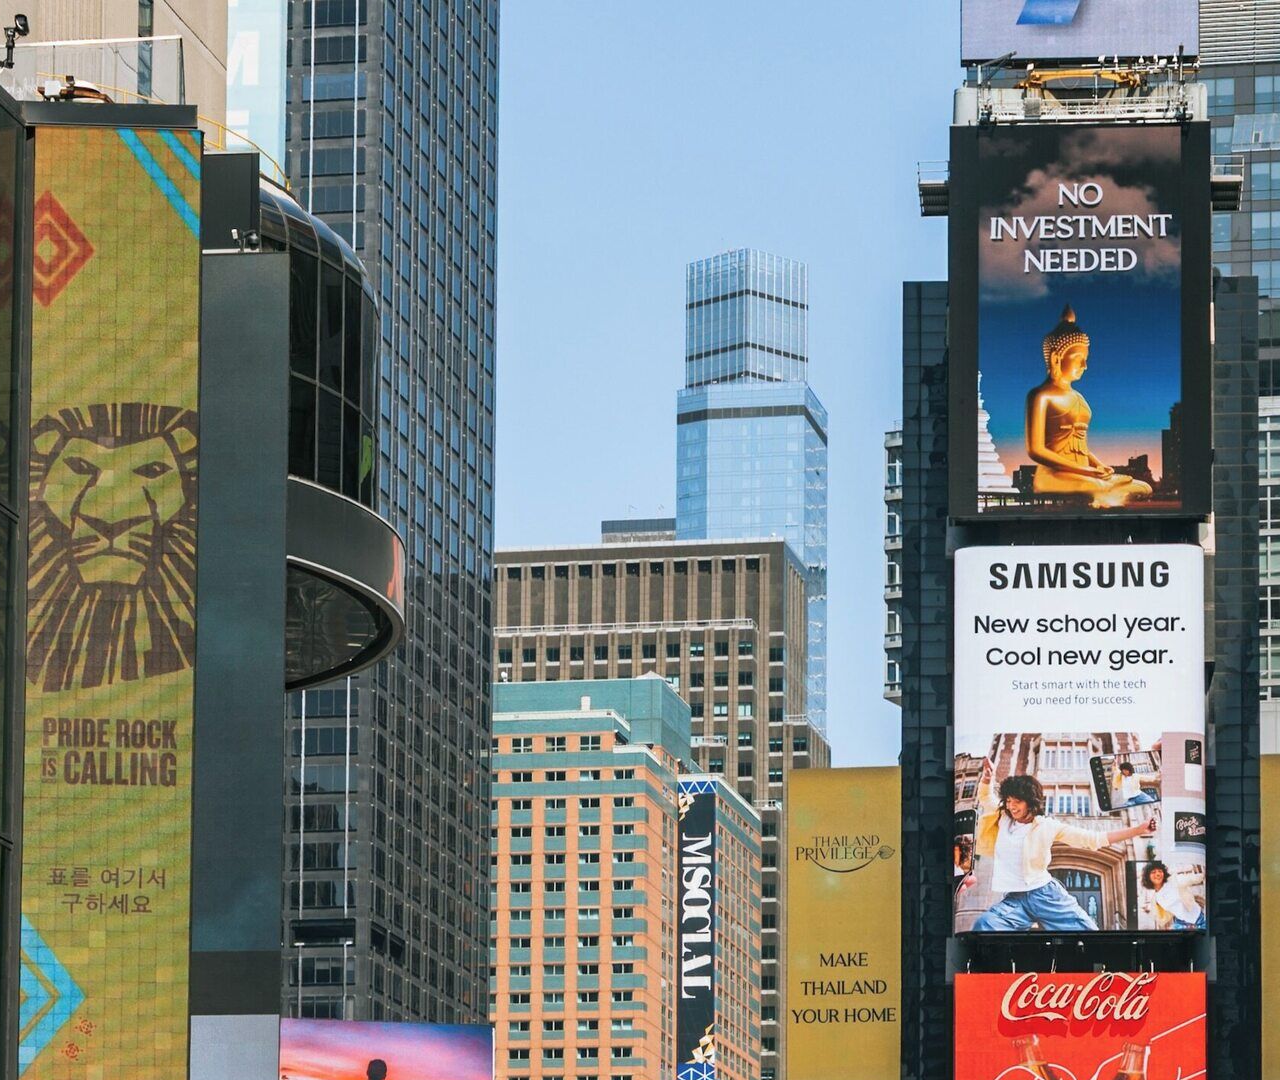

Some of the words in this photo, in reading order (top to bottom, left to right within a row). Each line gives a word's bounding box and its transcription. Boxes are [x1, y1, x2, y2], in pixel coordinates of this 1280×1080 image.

[1057, 182, 1103, 207] NO
[990, 213, 1172, 241] INVESTMENT
[1023, 247, 1138, 275] NEEDED
[989, 560, 1170, 590] SAMSUNG
[973, 614, 1030, 634] New
[1036, 613, 1117, 633] school
[1123, 615, 1186, 638] year.
[986, 646, 1041, 666] Cool
[1047, 649, 1102, 665] new
[1108, 648, 1174, 671] gear.
[1012, 679, 1039, 690] Start
[1041, 679, 1073, 690] smart
[1075, 678, 1100, 690] with
[1102, 678, 1121, 690] the
[1123, 678, 1147, 690] tech
[1023, 696, 1042, 707] you
[1045, 694, 1071, 705] need
[1074, 694, 1089, 705] for
[1091, 694, 1136, 705] success.
[43, 717, 110, 749] PRIDE
[115, 718, 177, 749] ROCK
[42, 756, 57, 778] IS
[63, 750, 177, 788] CALLING
[812, 834, 880, 848] THAILAND
[795, 846, 874, 862] PRIVILEGE
[47, 867, 92, 889] 표를
[100, 867, 166, 890] 여기서
[61, 893, 153, 915] 구하세요
[819, 952, 869, 968] MAKE
[801, 979, 888, 996] THAILAND
[791, 1008, 840, 1025] YOUR
[844, 1007, 897, 1024] HOME
